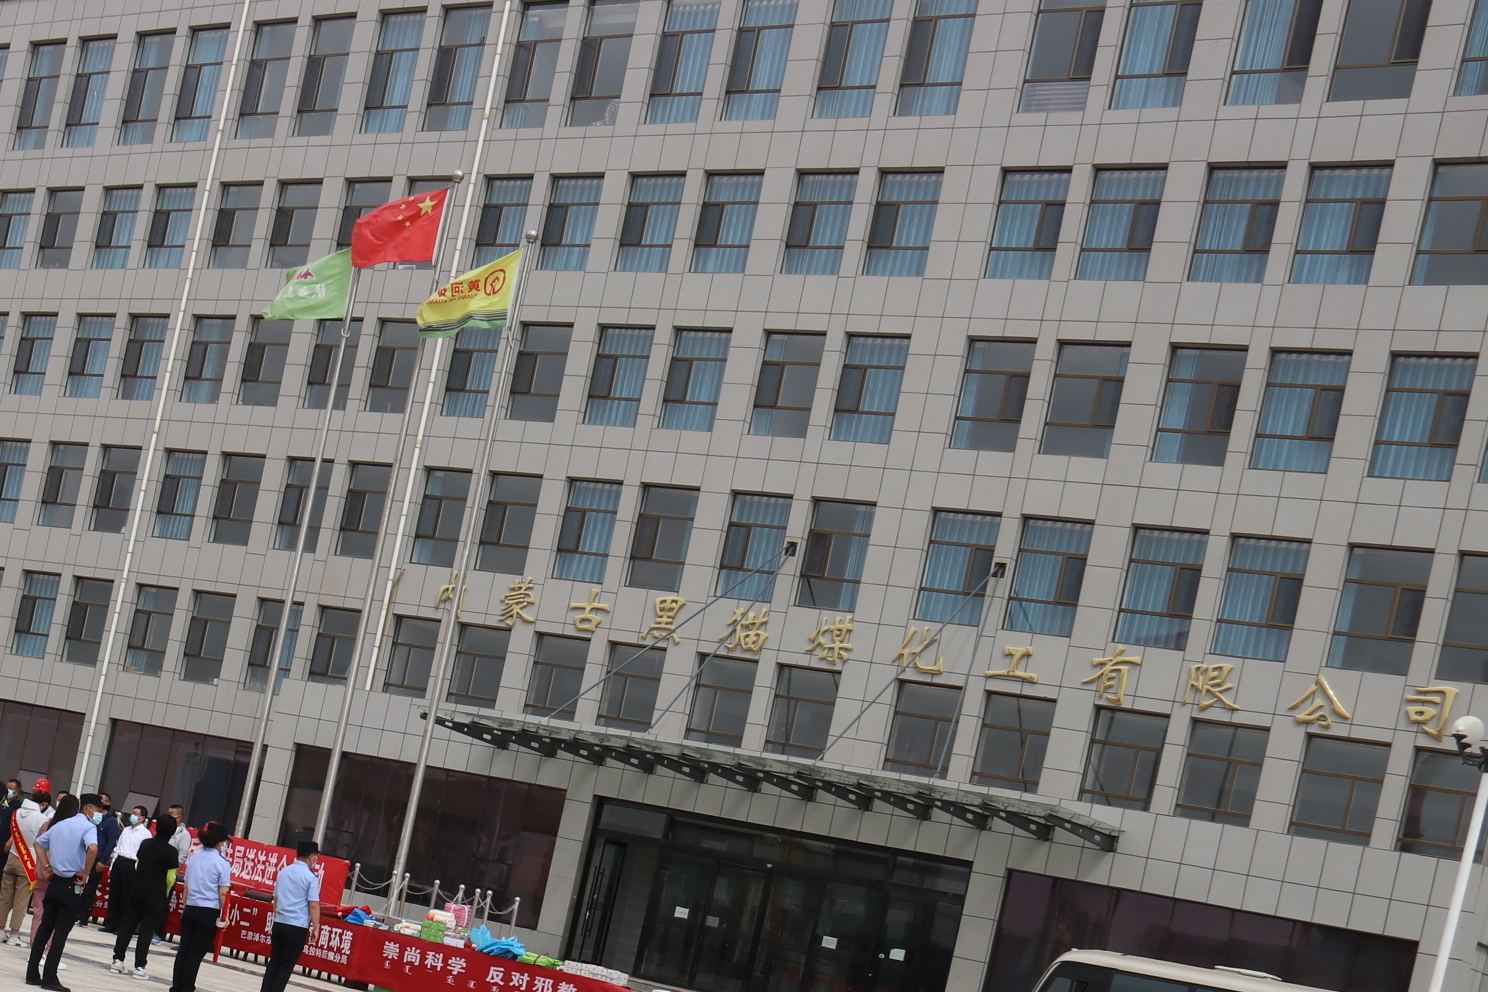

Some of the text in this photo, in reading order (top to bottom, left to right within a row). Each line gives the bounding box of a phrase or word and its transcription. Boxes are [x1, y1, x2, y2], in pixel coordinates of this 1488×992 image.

[435, 570, 1460, 742] 内蒙古黑猫煤化工有限公司
[382, 940, 466, 976] 崇尚科学
